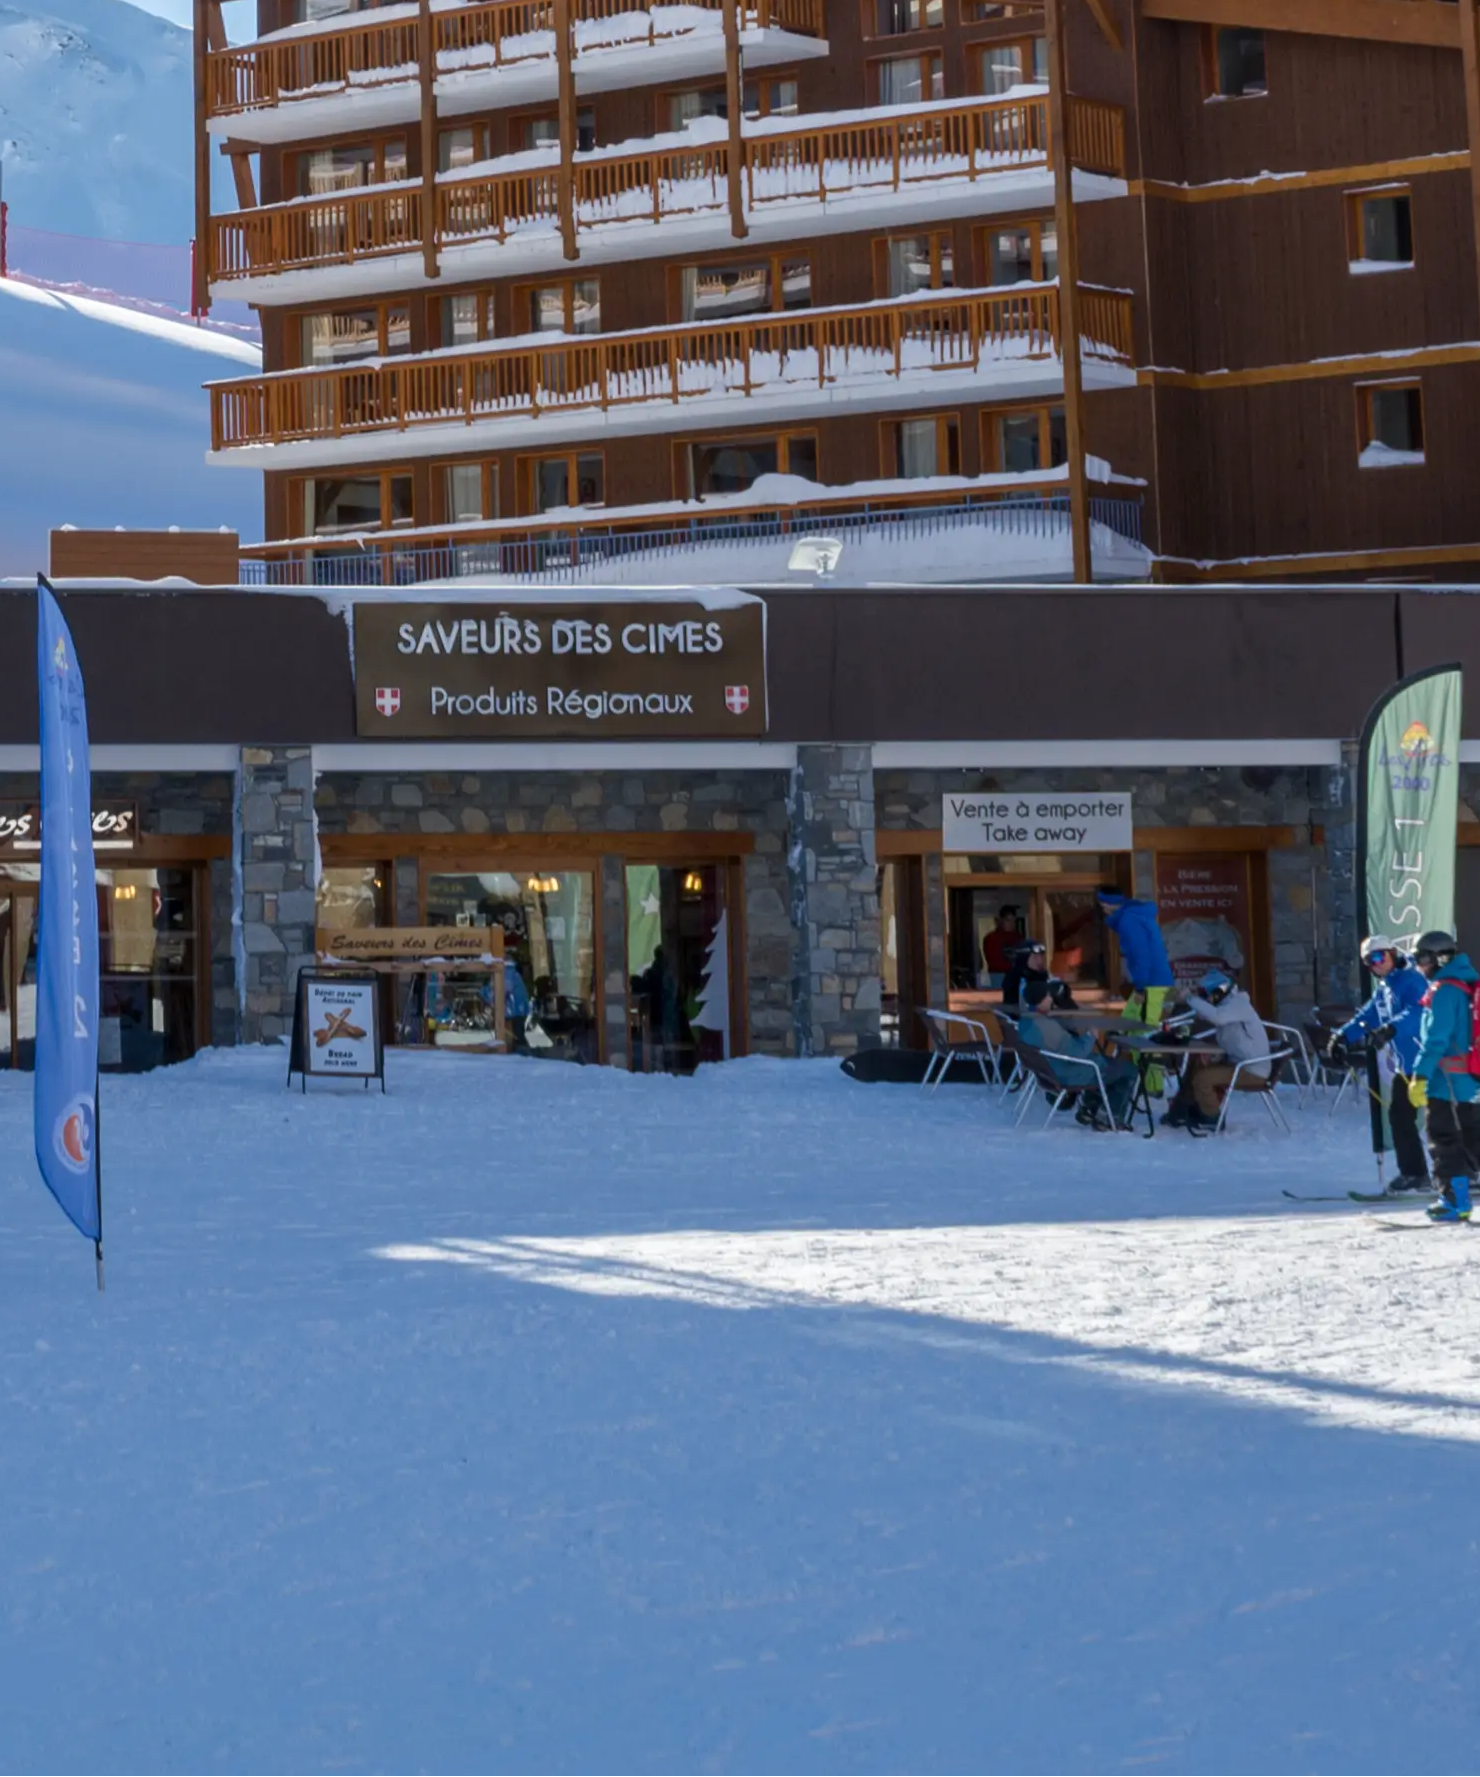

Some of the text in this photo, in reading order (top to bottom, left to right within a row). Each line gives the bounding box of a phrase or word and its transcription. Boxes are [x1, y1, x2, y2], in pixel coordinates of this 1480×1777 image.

[397, 619, 723, 655] SAVEURS DES CIMES
[431, 686, 693, 719] Produits Régionaux
[950, 799, 1124, 820] Vente à emporter
[981, 823, 1087, 844] Take away
[1179, 898, 1215, 908] VENTE
[1389, 851, 1423, 955] ASSE
[330, 934, 483, 950] Saveurs des Cimes
